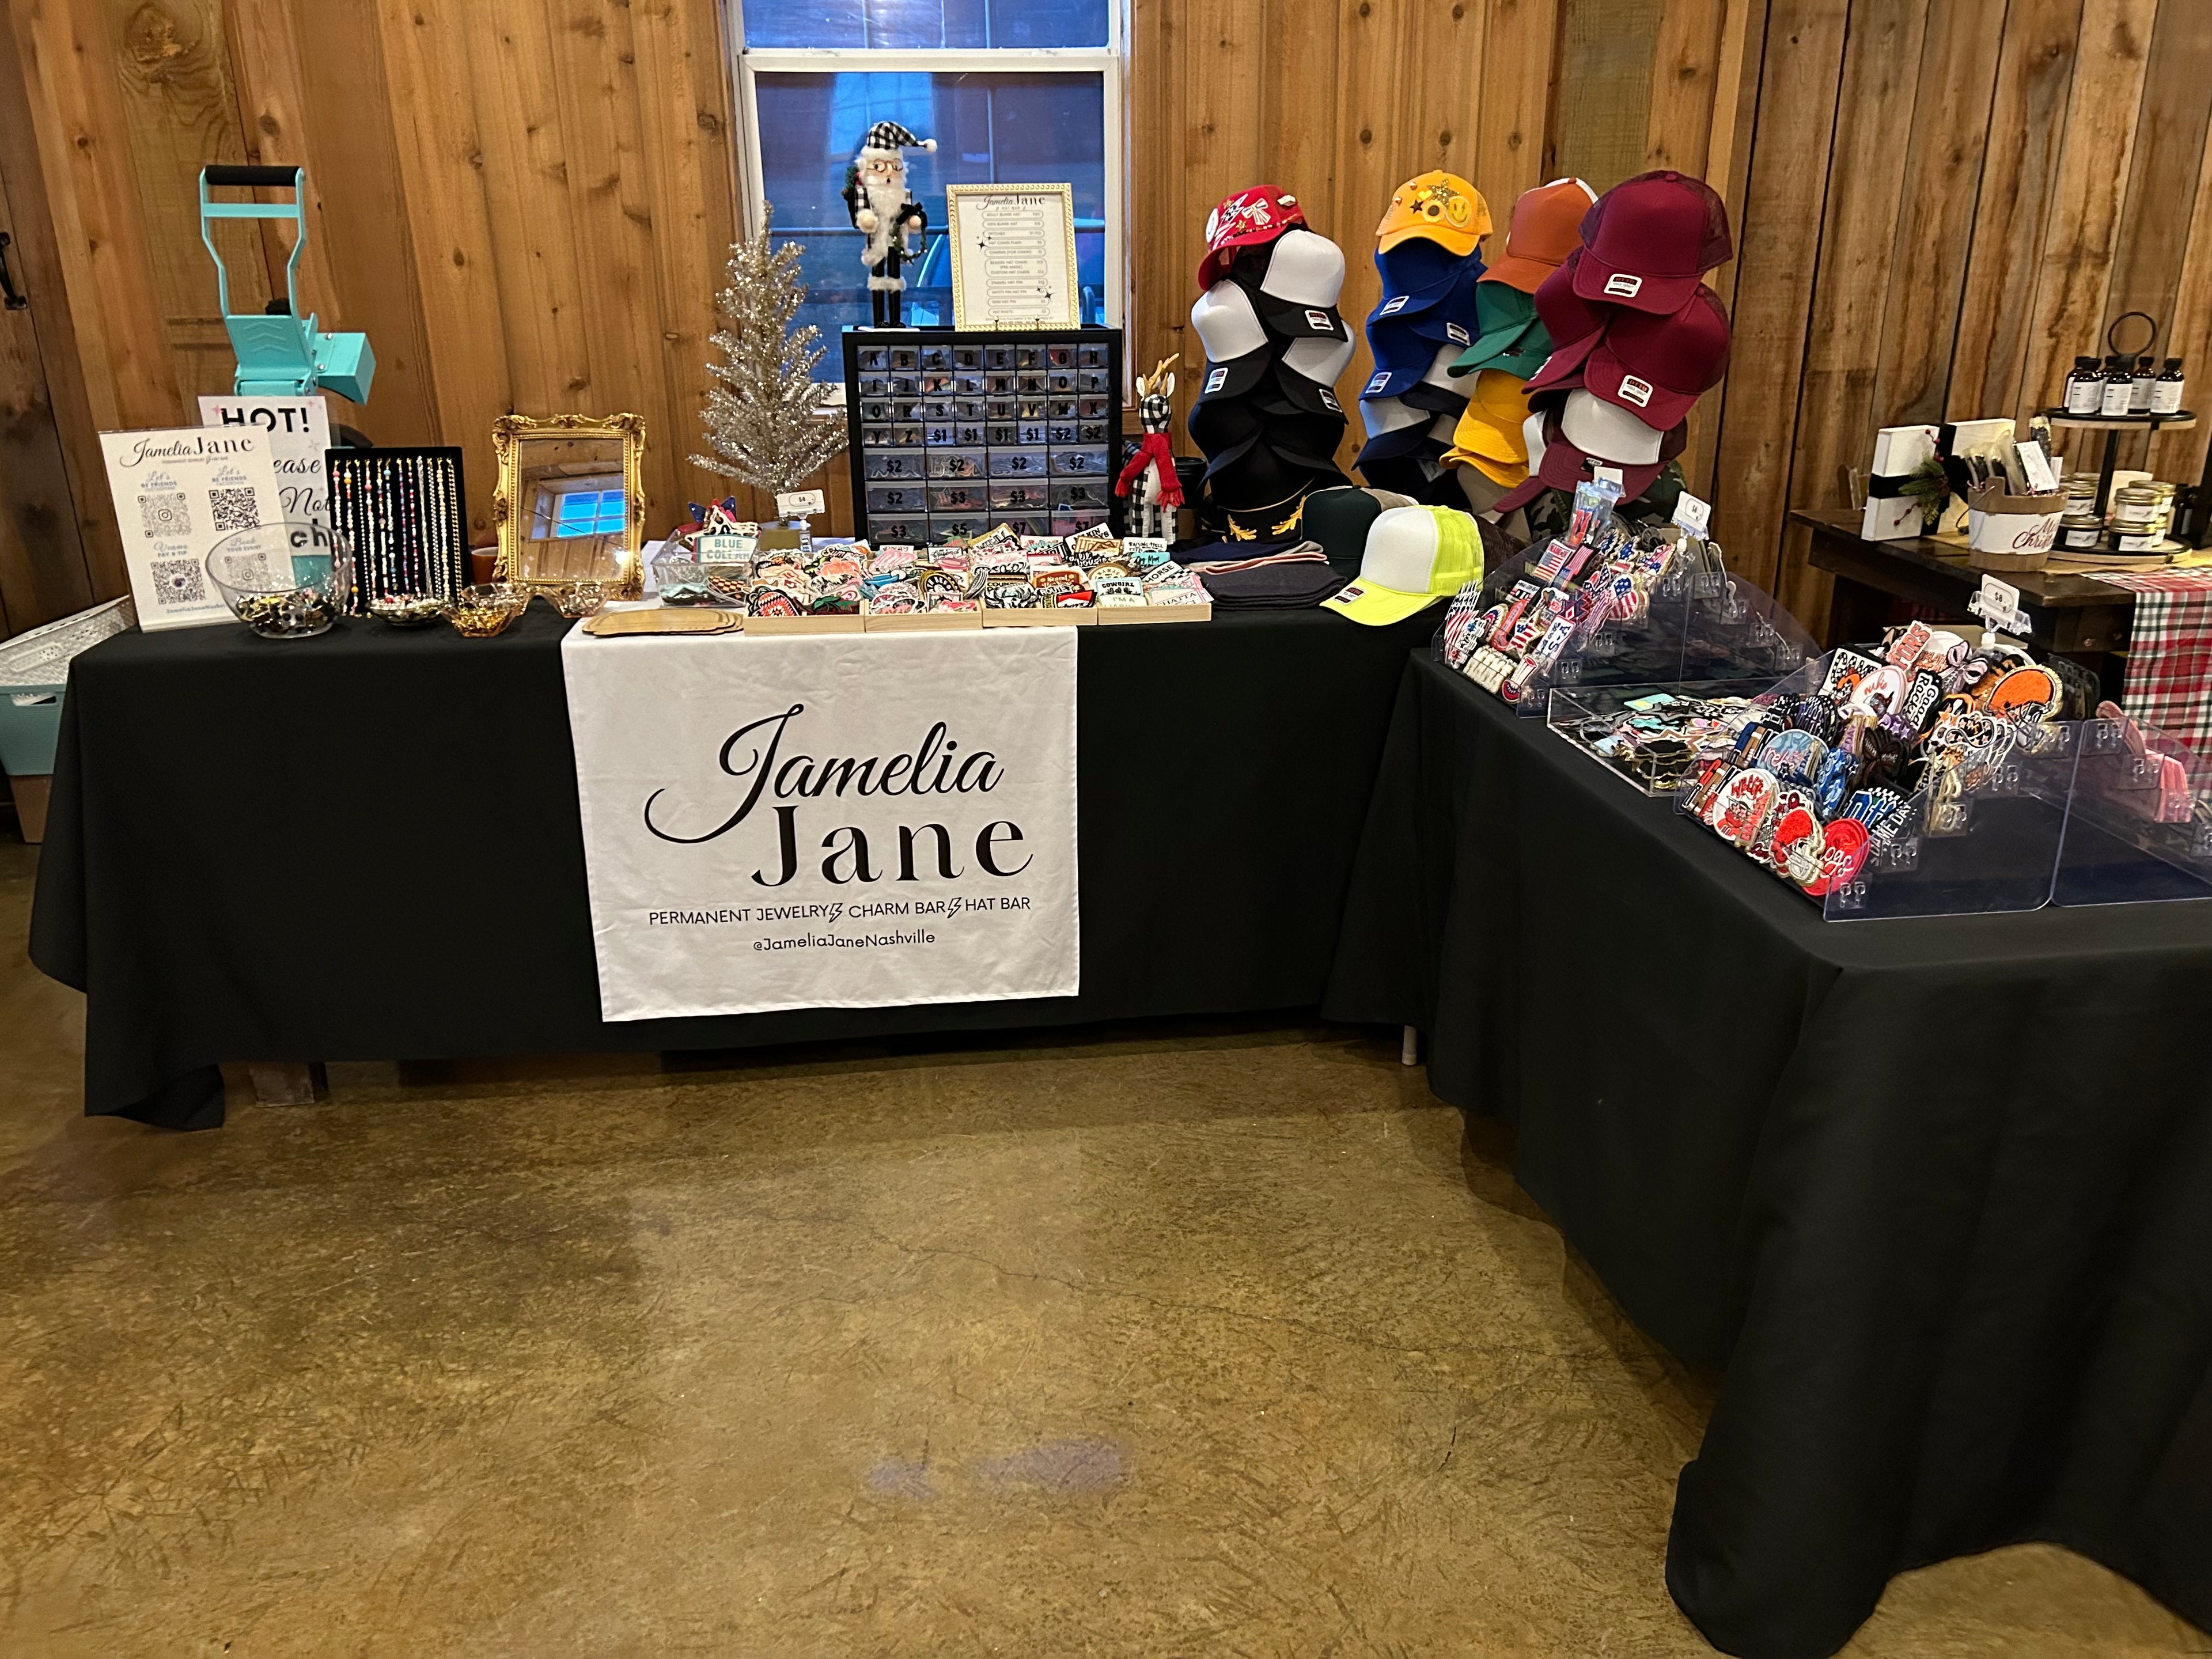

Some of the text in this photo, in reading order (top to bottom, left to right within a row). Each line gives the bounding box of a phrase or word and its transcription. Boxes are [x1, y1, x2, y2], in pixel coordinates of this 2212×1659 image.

[976, 195, 1045, 210] Jamelia Jane
[869, 351, 1097, 366] A B C D E F G H
[873, 376, 1099, 391] I J K L M N O P
[903, 405, 911, 417] R
[936, 404, 943, 417] S
[967, 404, 974, 416] T
[998, 403, 1005, 416] U
[1029, 403, 1036, 416] V
[1058, 403, 1069, 415] W
[1090, 403, 1097, 415] X
[221, 407, 310, 433] HOT!
[873, 427, 1100, 444] Y Z $1 $1 $1 $1 $2 $2
[120, 437, 254, 468] Jamelia Jane
[274, 459, 321, 474] ease
[887, 457, 1085, 473] $2 $2 $2 $2
[887, 487, 1086, 505] $2 $3 $3 $3
[892, 521, 1089, 537] $3 $5 $7 $7
[714, 539, 743, 548] BLUE
[1145, 565, 1175, 582] HORSE
[1040, 586, 1067, 595] ROUTE
[1914, 688, 1936, 726] Good
[645, 703, 1004, 844] Jamelia
[751, 805, 1033, 887] Jane
[649, 896, 1031, 925] PERMANENT JEWELRY CHARM BAR HAT BAR
[753, 930, 936, 952] @JameliaJaneNashville
